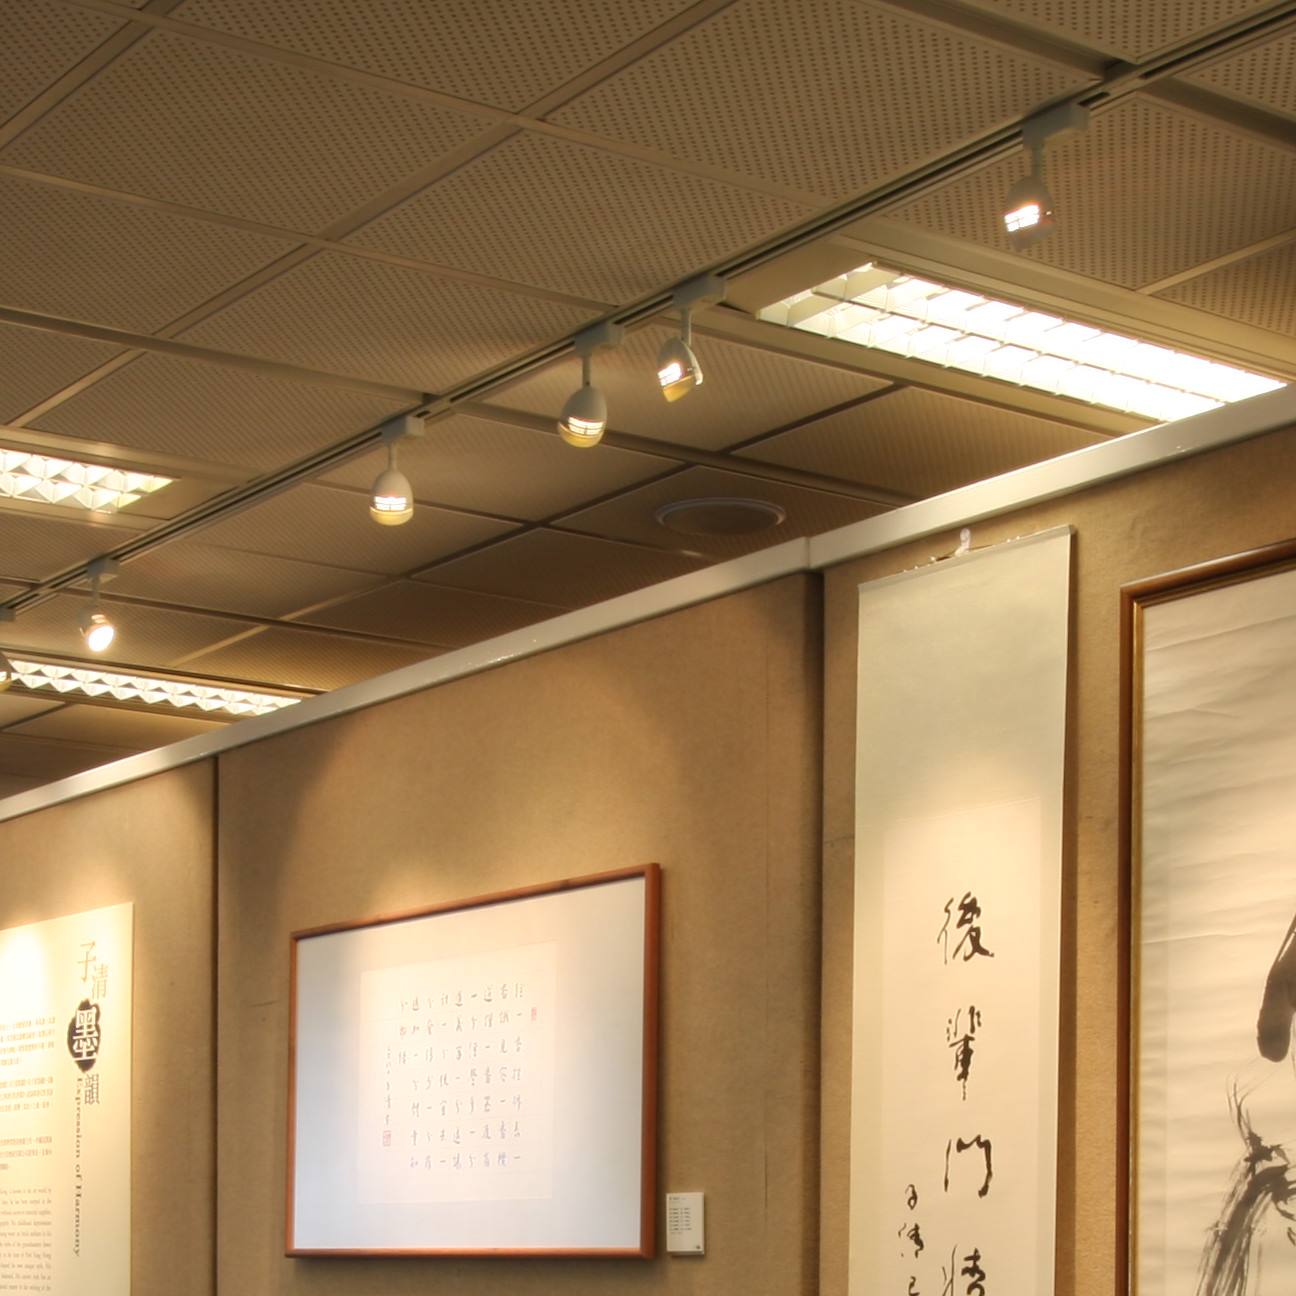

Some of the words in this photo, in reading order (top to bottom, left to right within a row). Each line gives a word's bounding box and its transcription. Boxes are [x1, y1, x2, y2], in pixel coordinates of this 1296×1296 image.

[75, 1077, 83, 1158] Expression
[75, 1162, 83, 1181] of
[74, 1184, 83, 1258] Harmony
